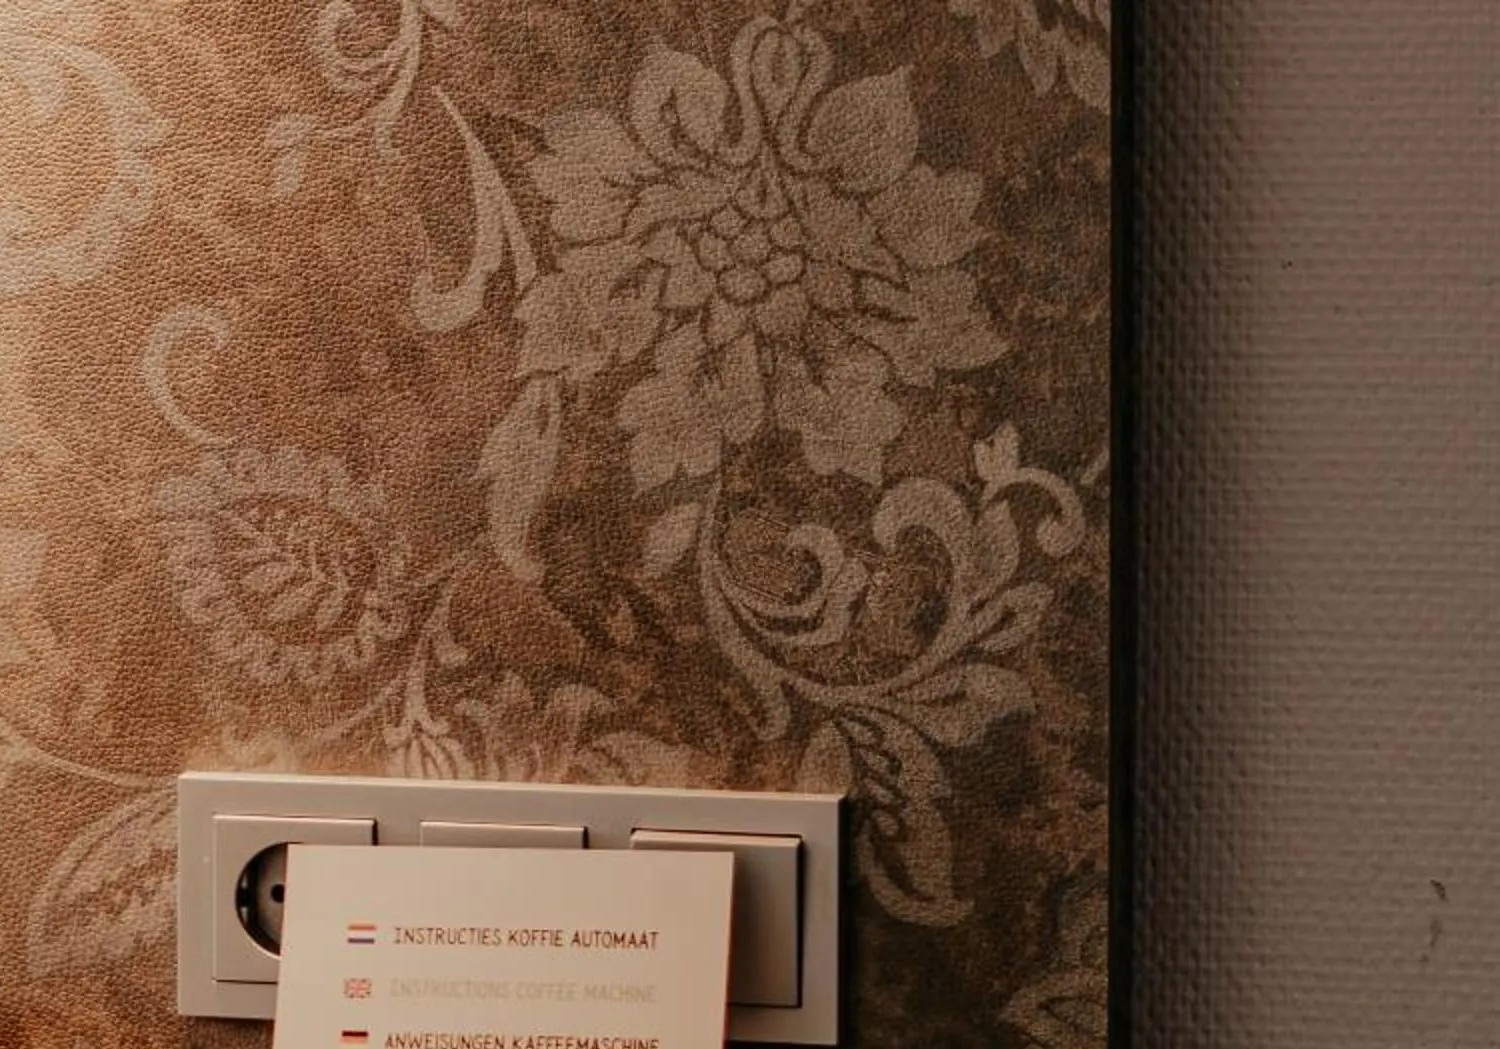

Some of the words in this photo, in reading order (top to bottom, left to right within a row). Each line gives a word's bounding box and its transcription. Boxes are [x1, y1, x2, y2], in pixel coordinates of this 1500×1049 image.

[393, 926, 503, 946] INSTRUCTIES
[507, 928, 564, 947] KOFFIE
[571, 929, 660, 950] AUTOMAAT
[389, 978, 510, 999] INSTRUCTIONS
[516, 981, 577, 1002] COFFEE
[584, 983, 658, 1003] MACHINE
